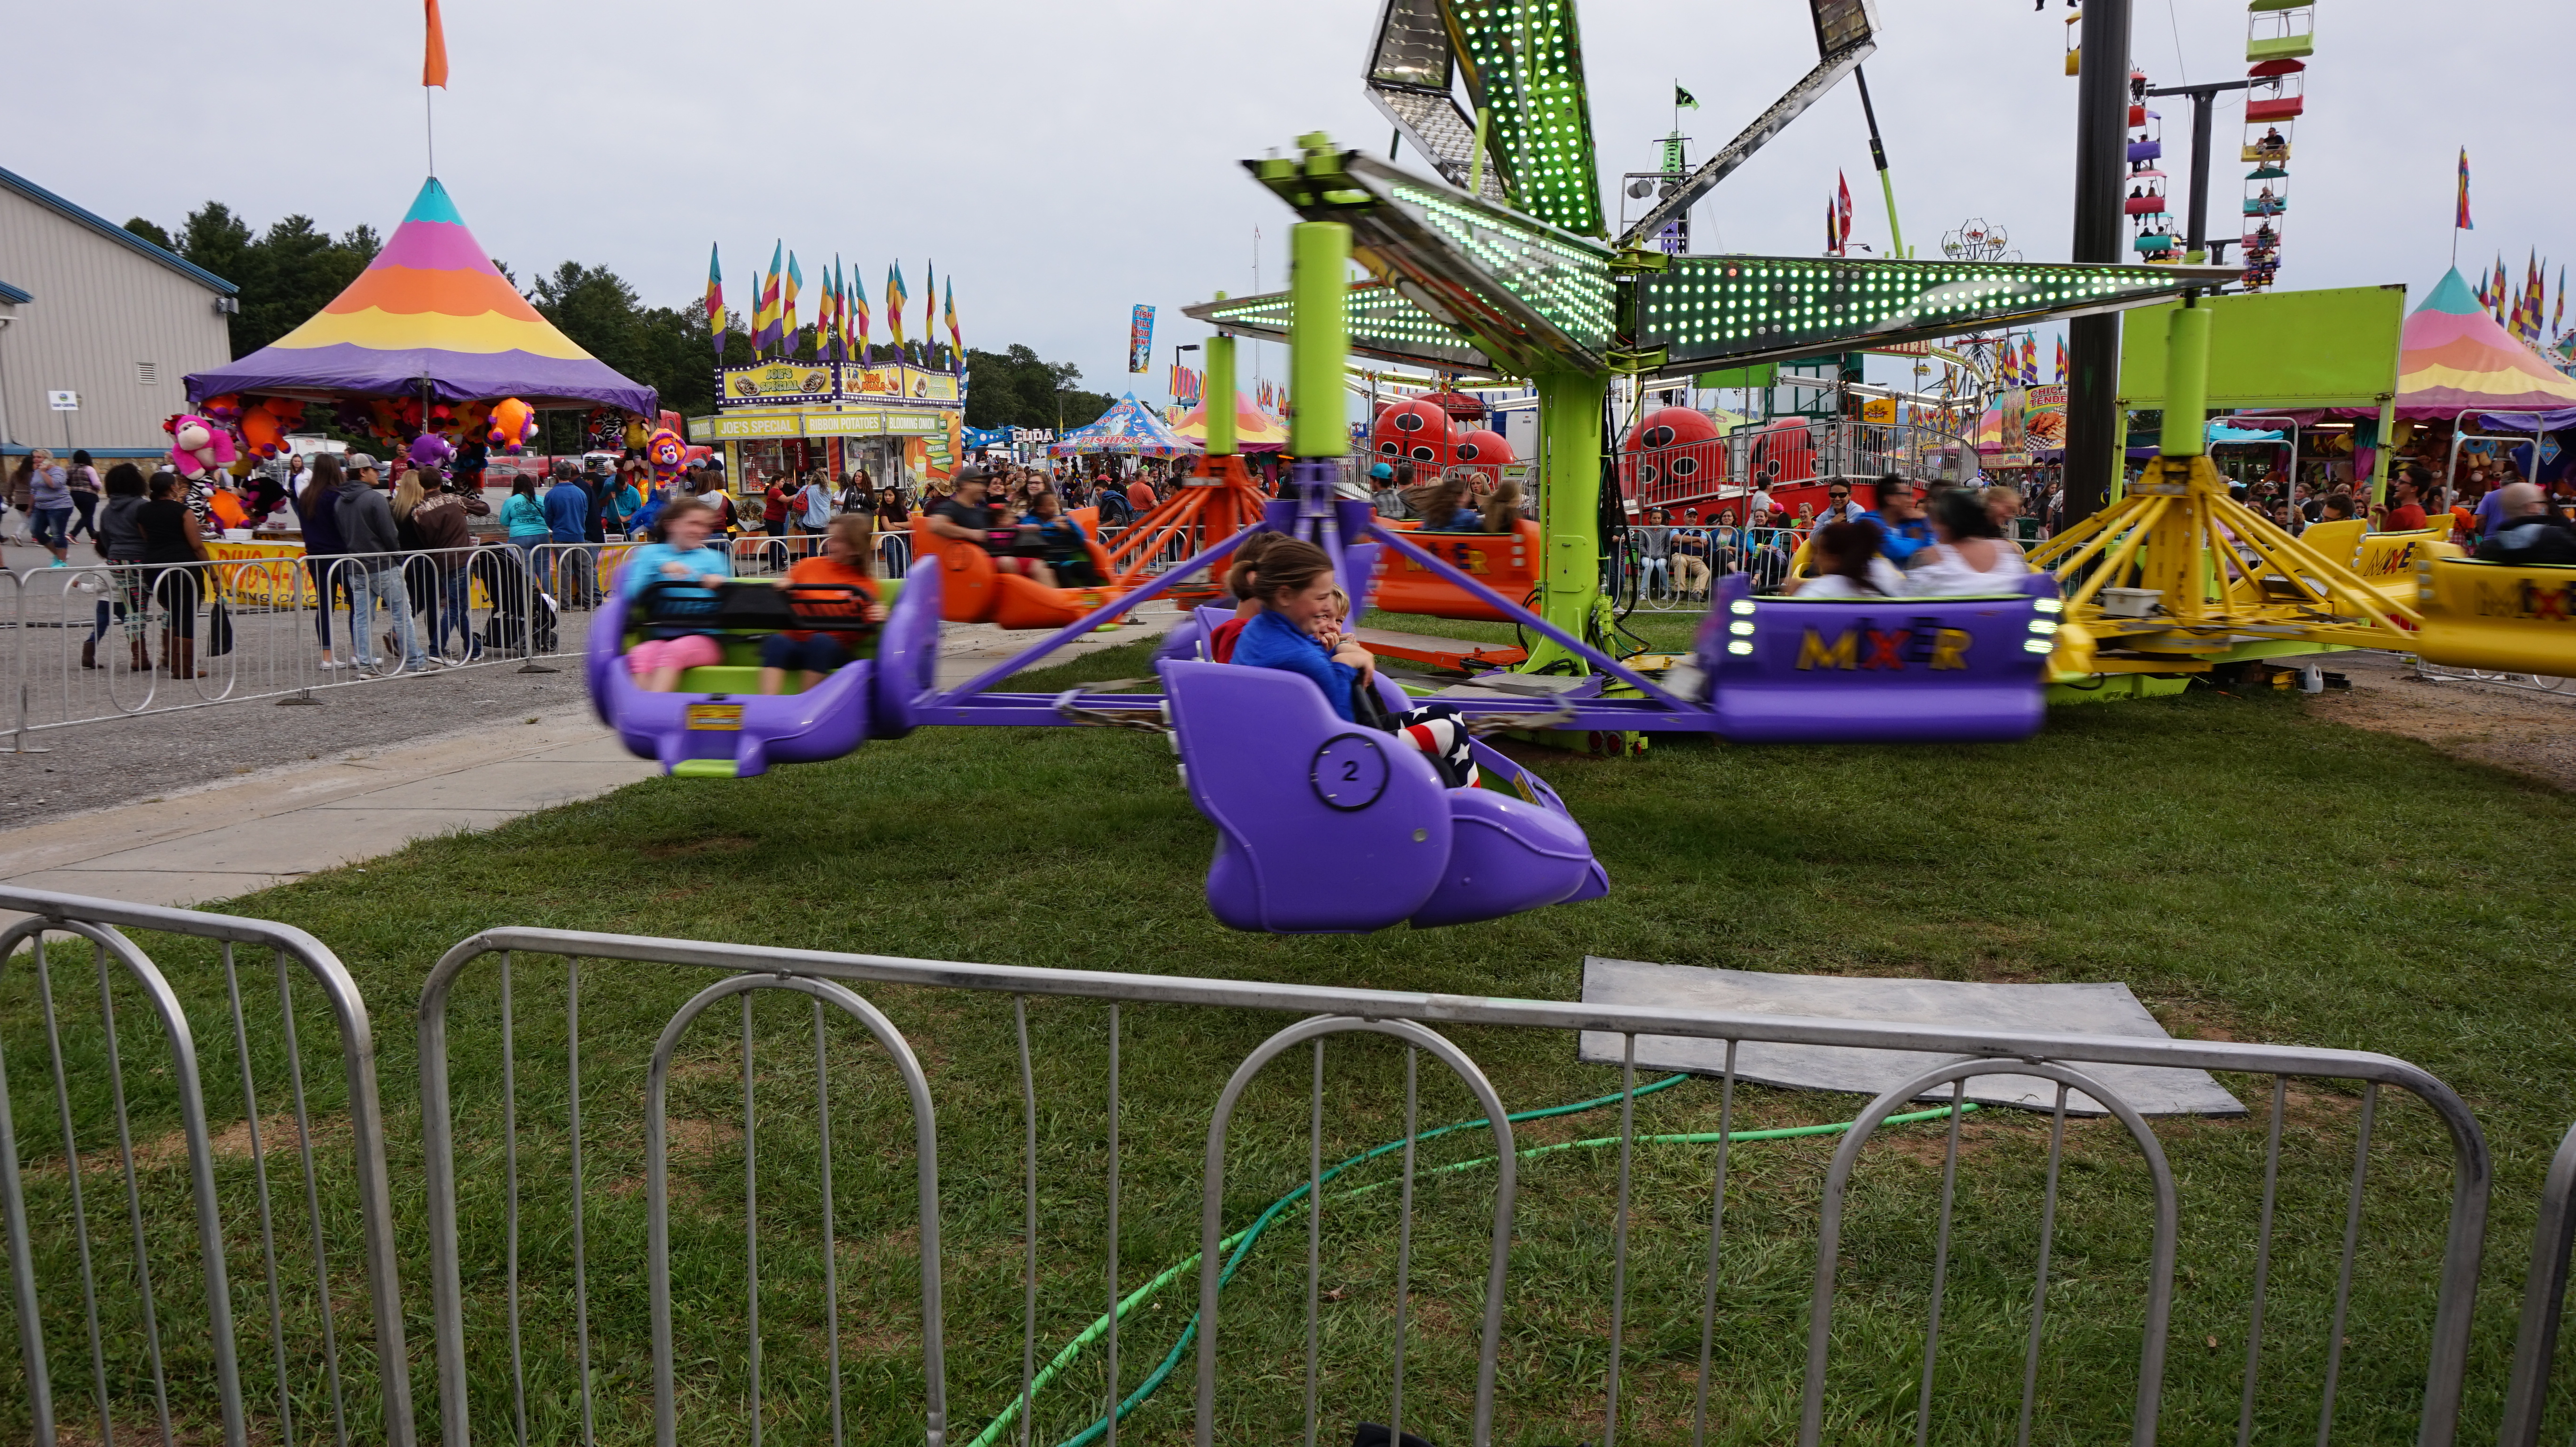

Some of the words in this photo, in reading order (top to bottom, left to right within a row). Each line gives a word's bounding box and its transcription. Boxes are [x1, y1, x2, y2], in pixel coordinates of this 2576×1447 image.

[1134, 310, 1152, 319] FISH
[1135, 319, 1151, 328] TILL
[1134, 328, 1150, 337] YOU
[1133, 338, 1150, 346] WIN!
[766, 368, 793, 380] JOE'S
[864, 373, 880, 383] KIDS
[760, 381, 800, 392] SPECIAL
[862, 382, 885, 391] MEALS
[1110, 404, 1136, 415] LET'S
[720, 421, 749, 434] JOE'S
[751, 419, 794, 433] SPECIAL
[809, 417, 839, 431] RIBBON
[840, 416, 879, 430] POTATOES
[889, 417, 918, 429] BLOOMING
[919, 418, 935, 430] ONION
[1095, 416, 1111, 426] GO
[691, 424, 701, 436] CORN
[700, 422, 711, 435] DOGS
[1012, 430, 1054, 441] CUDA
[1079, 436, 1143, 444] FISHING
[2363, 542, 2421, 577] MIXER
[1794, 616, 1974, 672] MIXER
[1342, 760, 1359, 781] 2
